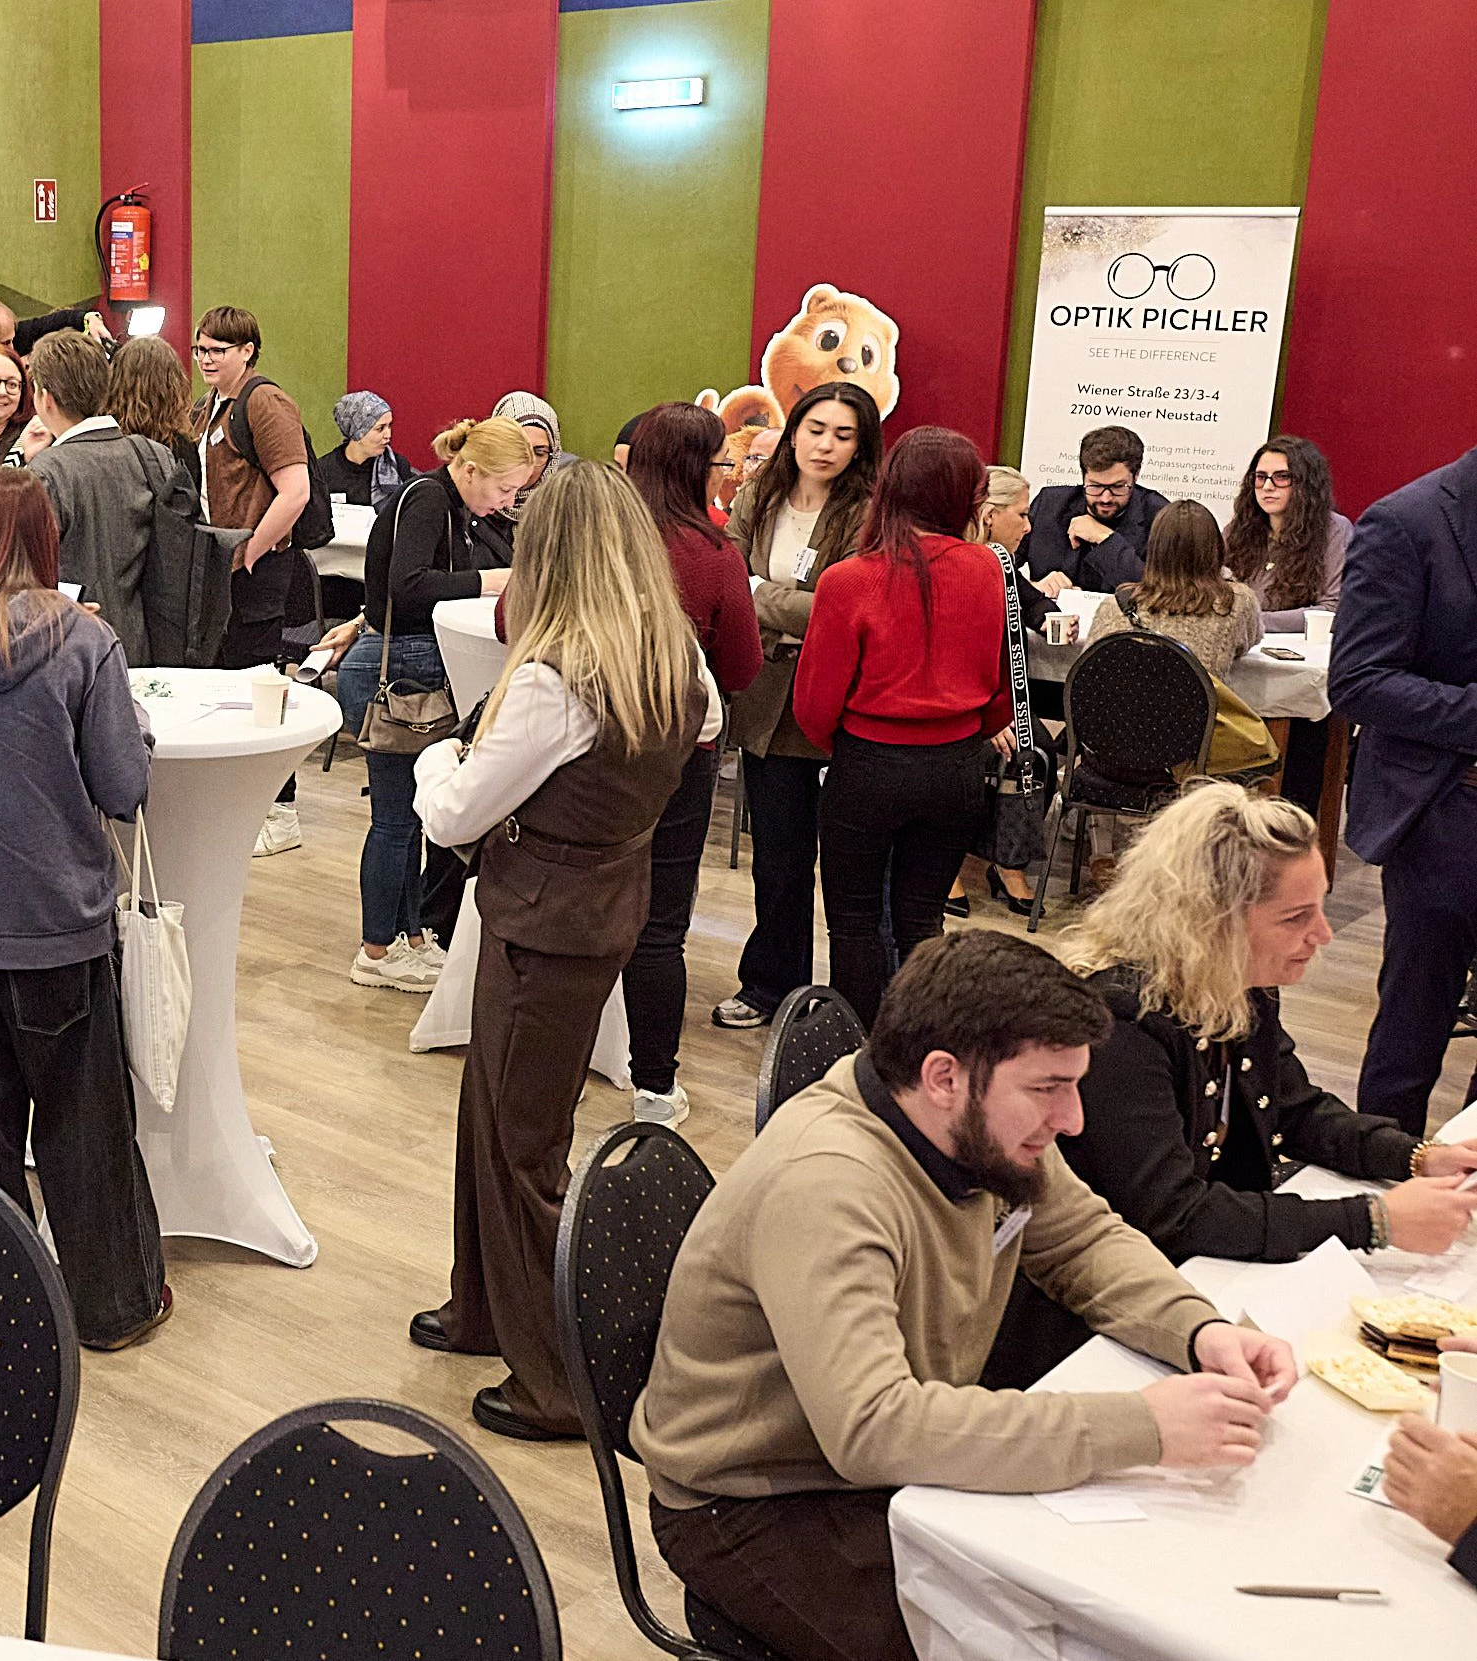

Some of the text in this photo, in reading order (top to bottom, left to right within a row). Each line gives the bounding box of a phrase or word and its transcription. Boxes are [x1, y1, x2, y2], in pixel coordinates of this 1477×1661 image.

[1050, 305, 1268, 333] OPTIK PICHLER
[1089, 347, 1217, 362] SEE THE DIFFERENCE
[1077, 383, 1220, 401] Wiener Straße 23/3-4
[1070, 404, 1218, 423] 2700 Wiener Neustadt
[1144, 445, 1215, 456] atung mit Herz
[1147, 458, 1235, 471] Anpassungstechnik
[1140, 473, 1180, 482] enbrillen
[1182, 475, 1189, 483] &
[1160, 489, 1201, 500] einigung
[1007, 586, 1018, 632] GUESS
[1012, 644, 1025, 690] GUESS
[1017, 702, 1030, 747] GUESS
